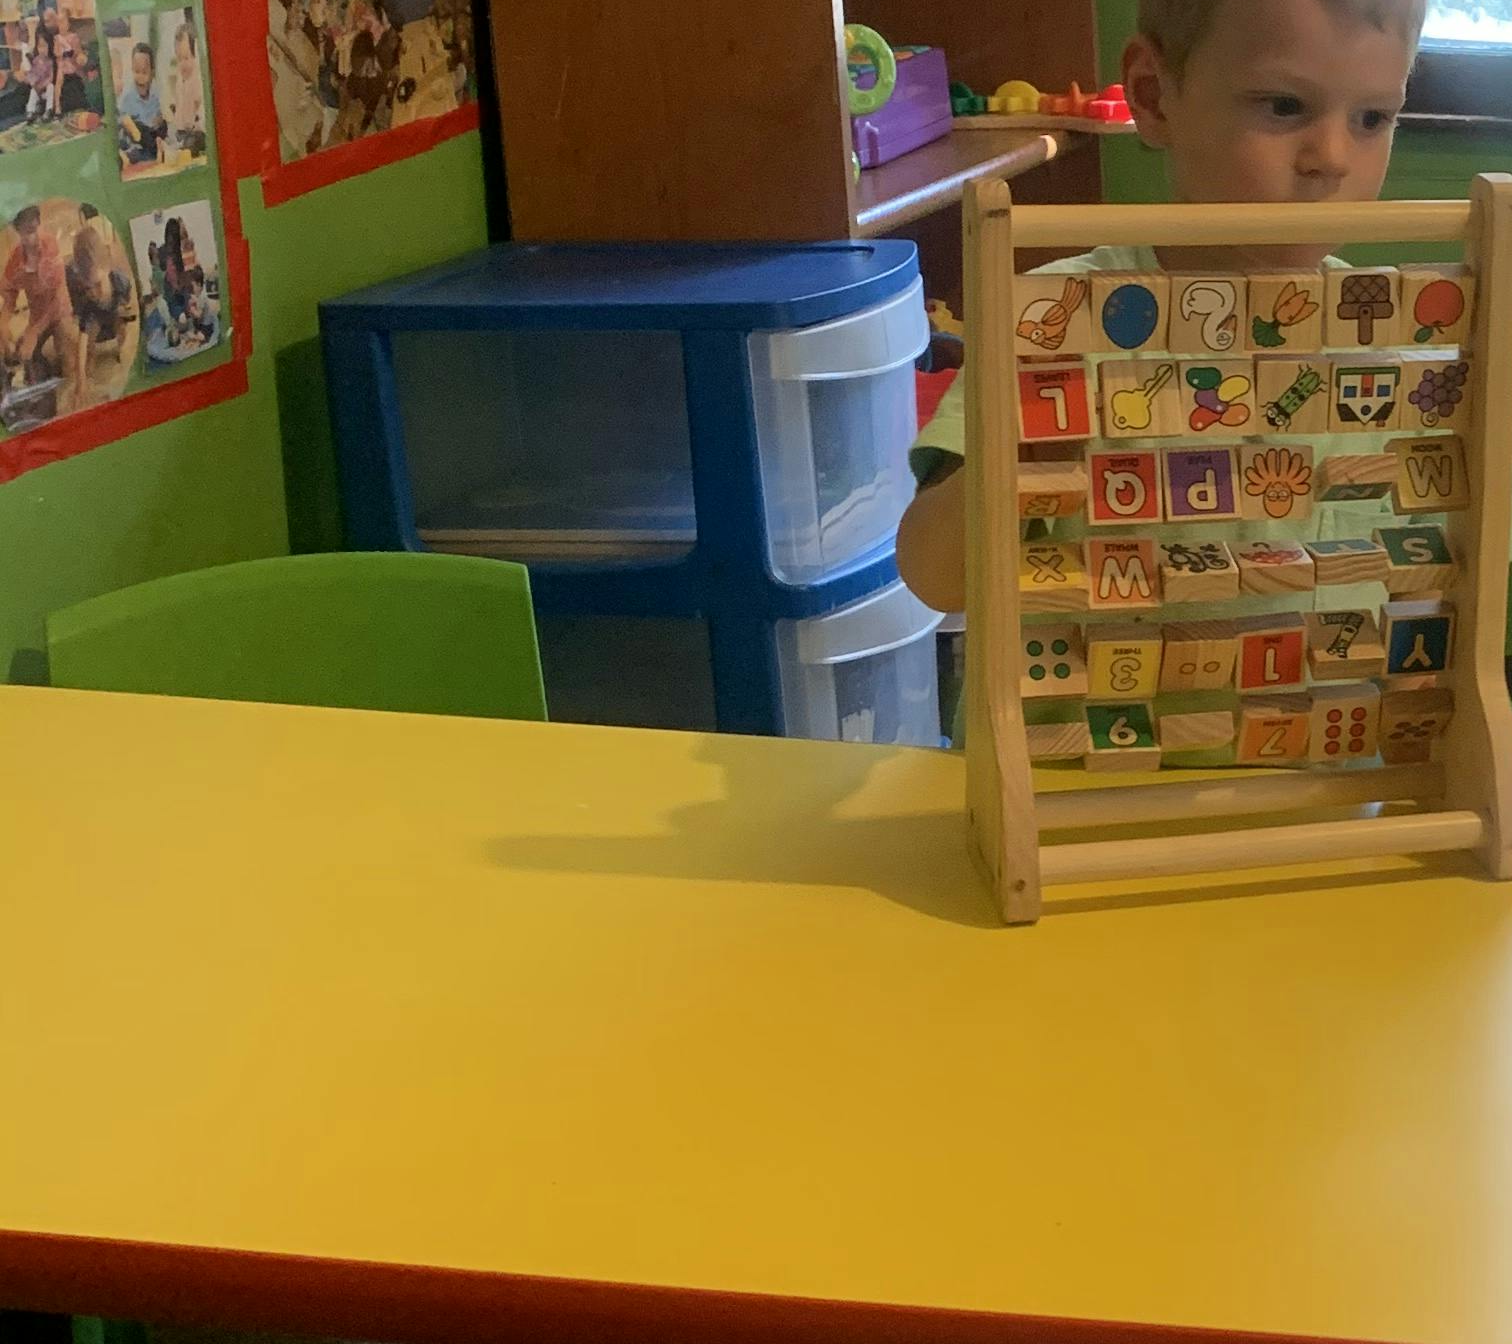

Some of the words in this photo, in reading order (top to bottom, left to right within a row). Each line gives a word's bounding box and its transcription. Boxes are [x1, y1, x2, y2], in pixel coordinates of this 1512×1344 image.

[1040, 386, 1069, 431] L
[1104, 469, 1146, 516] Q
[1187, 468, 1218, 511] P
[1026, 554, 1067, 583] X
[1402, 537, 1434, 563] S
